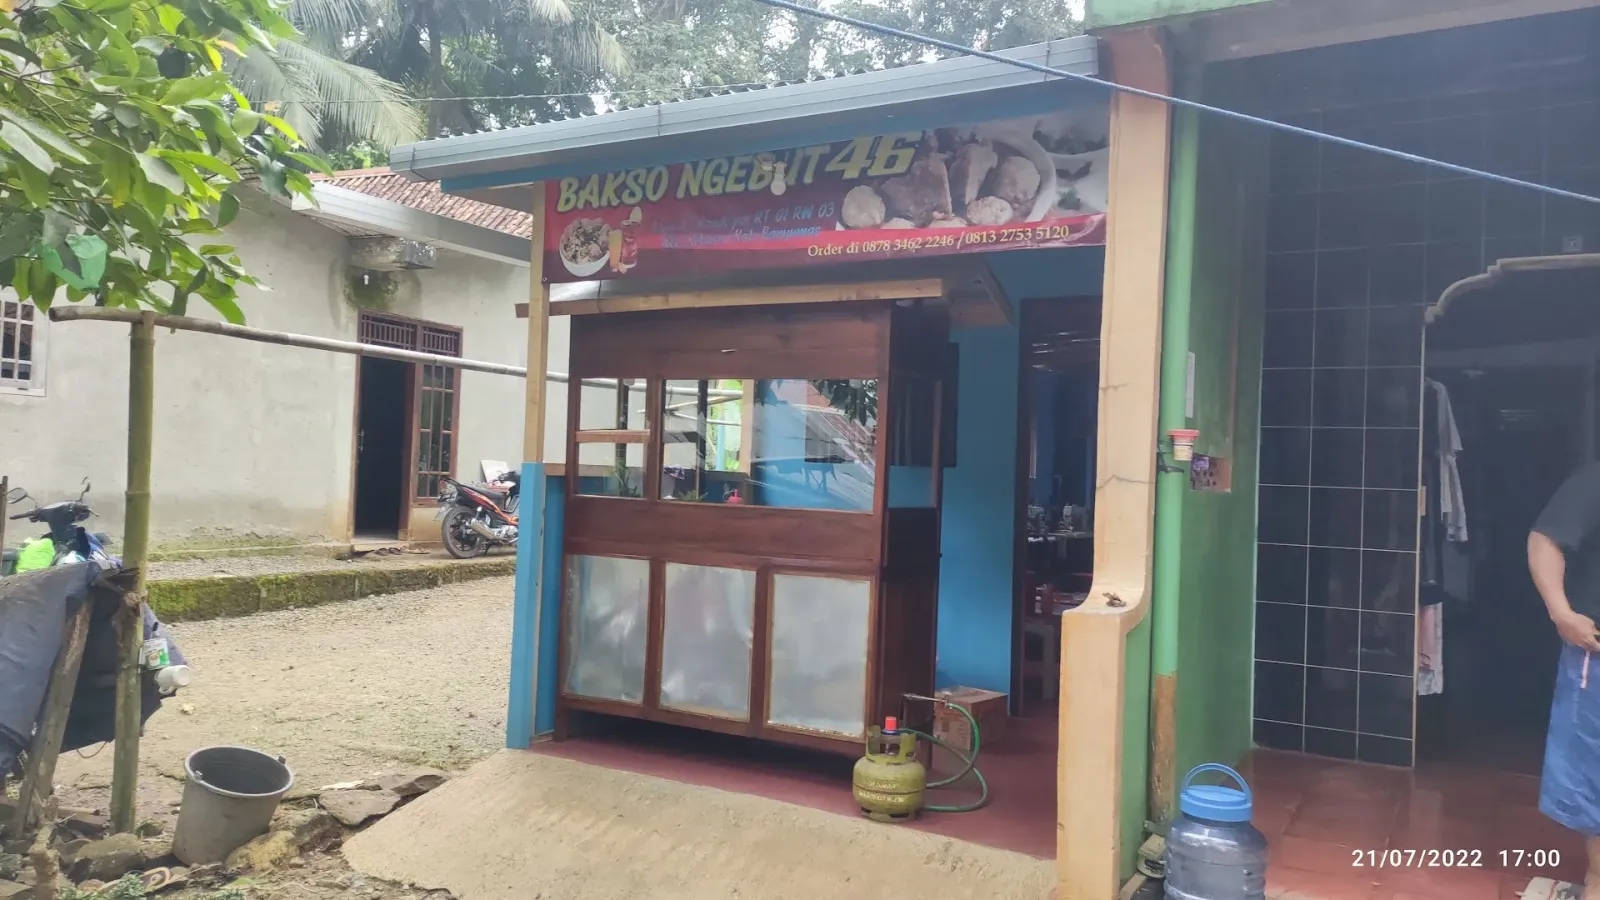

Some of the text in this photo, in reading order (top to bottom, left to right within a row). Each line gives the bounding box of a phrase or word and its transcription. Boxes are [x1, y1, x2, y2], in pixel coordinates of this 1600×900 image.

[557, 131, 922, 212] BAKSO NGEBUT 46
[818, 201, 835, 217] 03
[807, 243, 844, 257] Order
[846, 241, 860, 254] di
[862, 239, 891, 253] 0878
[893, 236, 922, 251] 3462
[924, 234, 954, 248] 2246
[1000, 227, 1032, 242] 2753
[1035, 225, 1069, 240] 5120
